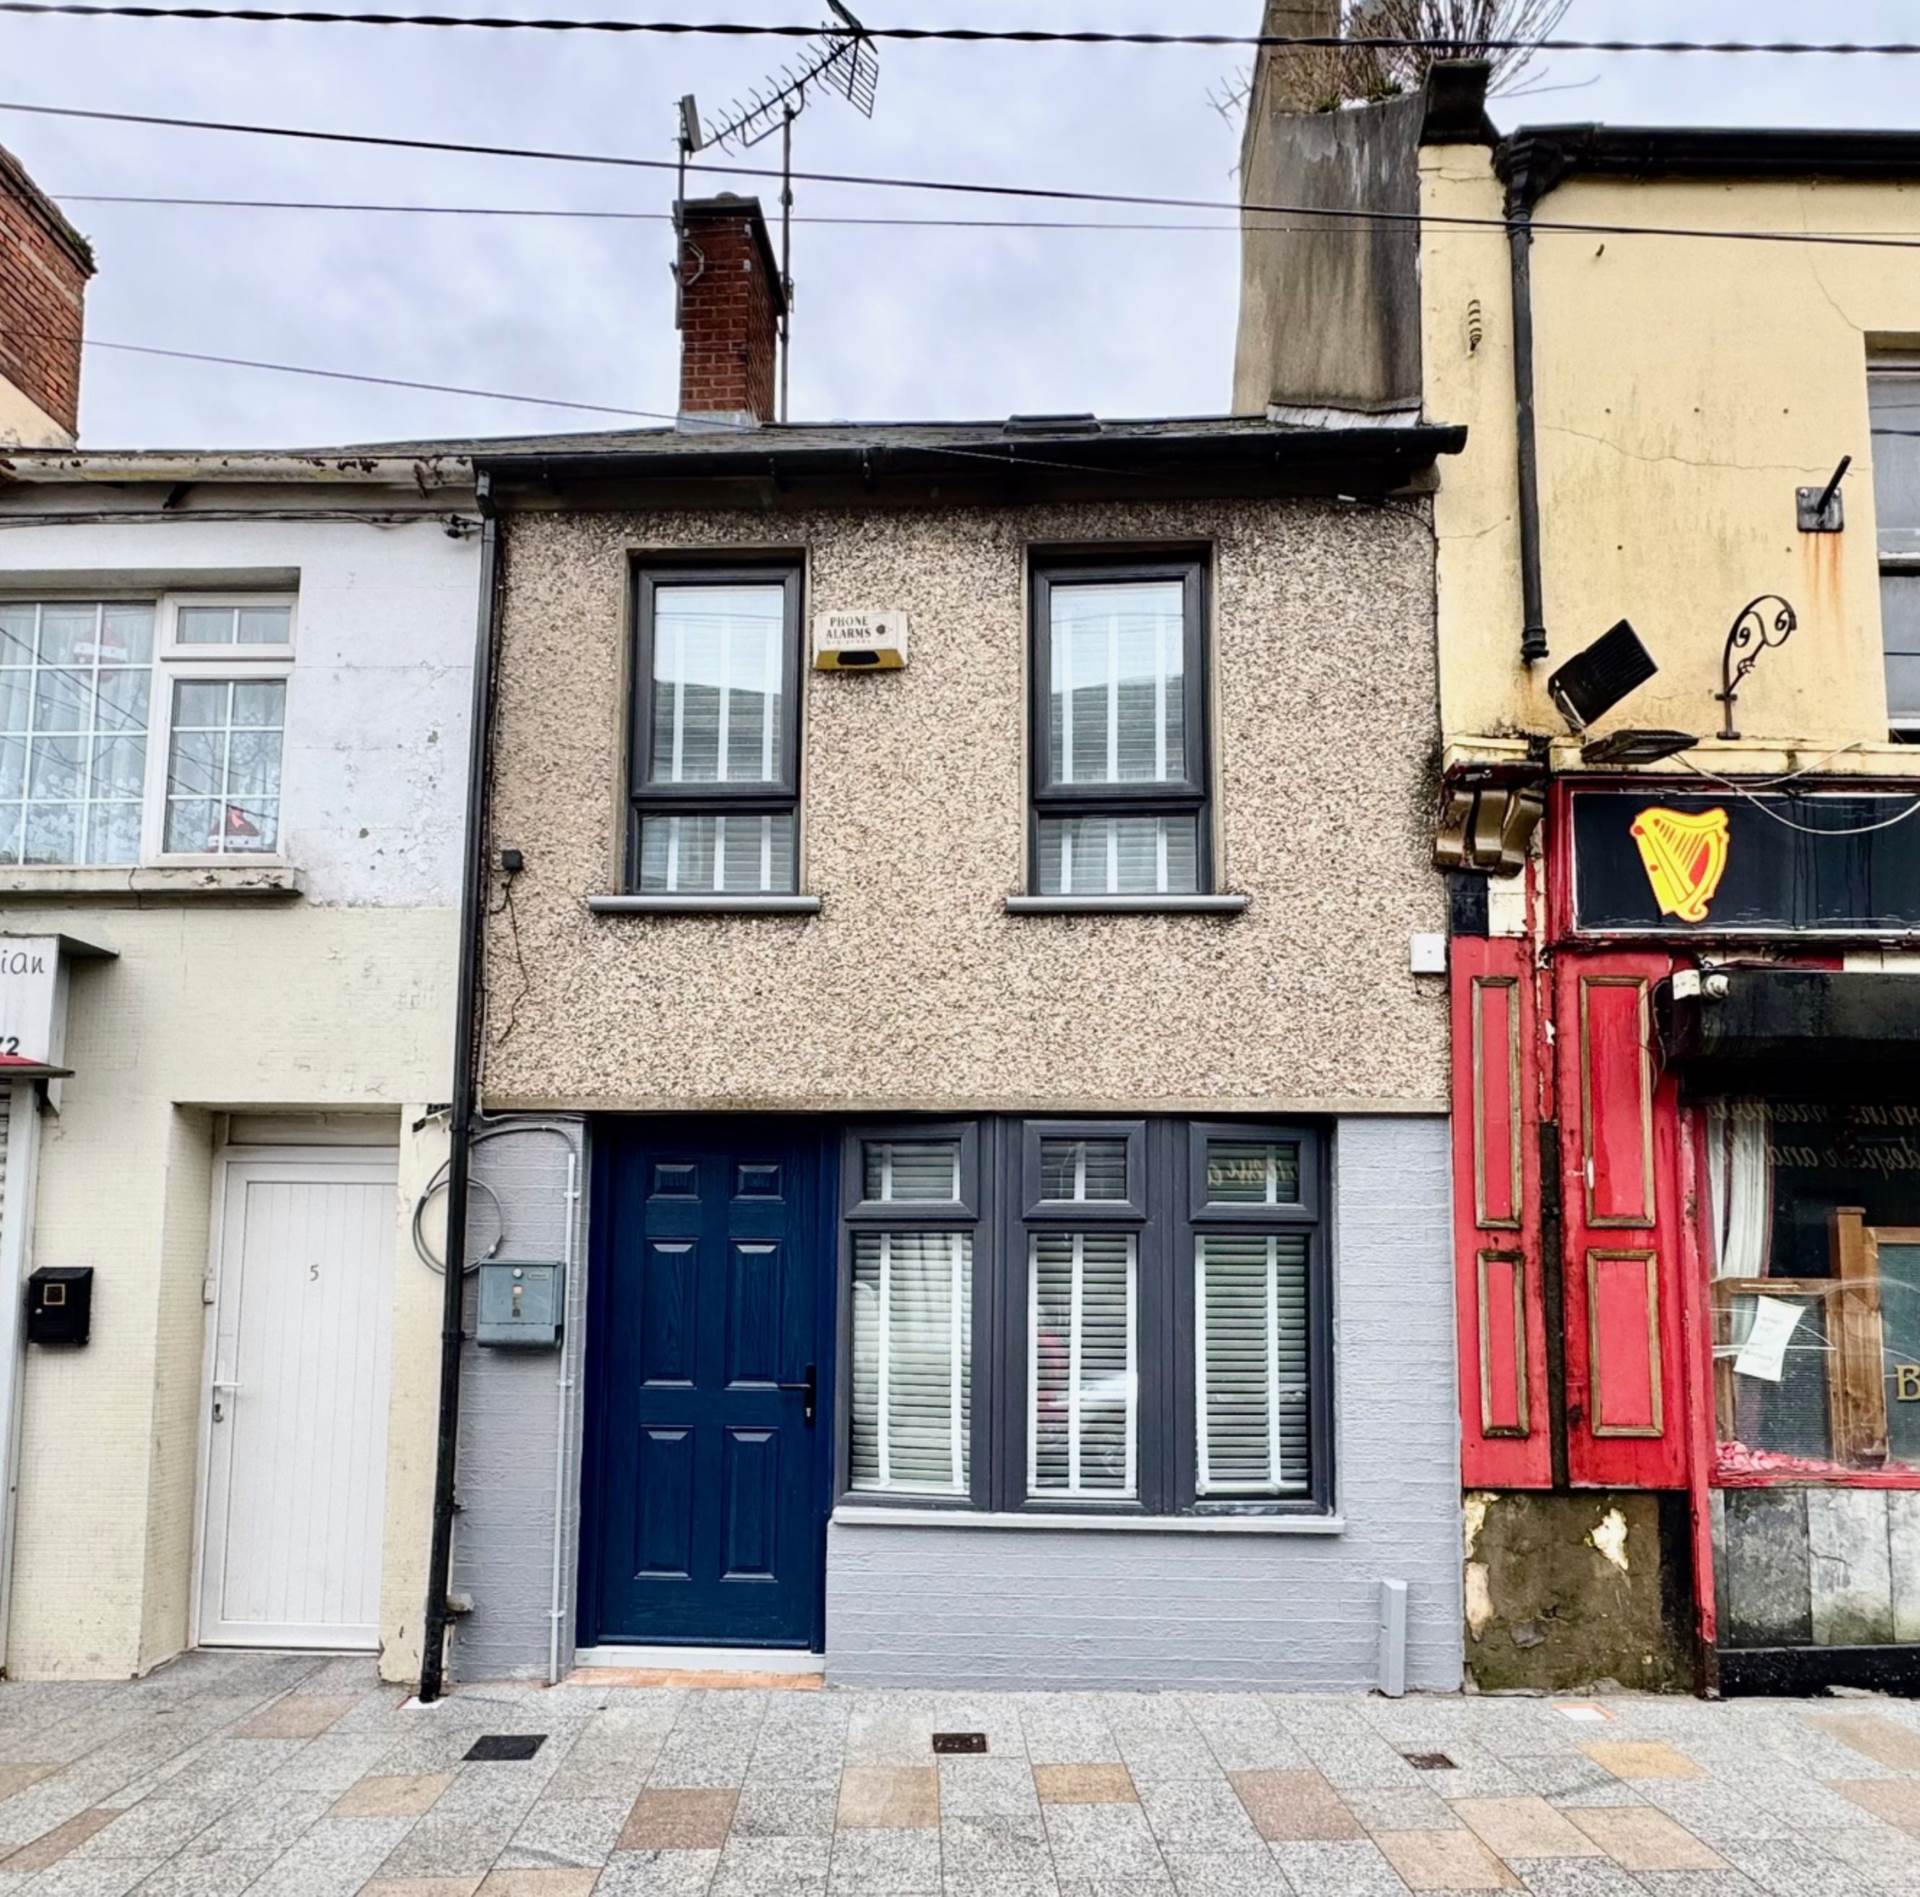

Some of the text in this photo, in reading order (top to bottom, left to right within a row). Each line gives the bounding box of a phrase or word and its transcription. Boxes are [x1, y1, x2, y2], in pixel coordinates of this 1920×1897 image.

[830, 616, 869, 627] PHONE
[826, 627, 871, 639] ALARMS
[310, 1264, 319, 1281] 5
